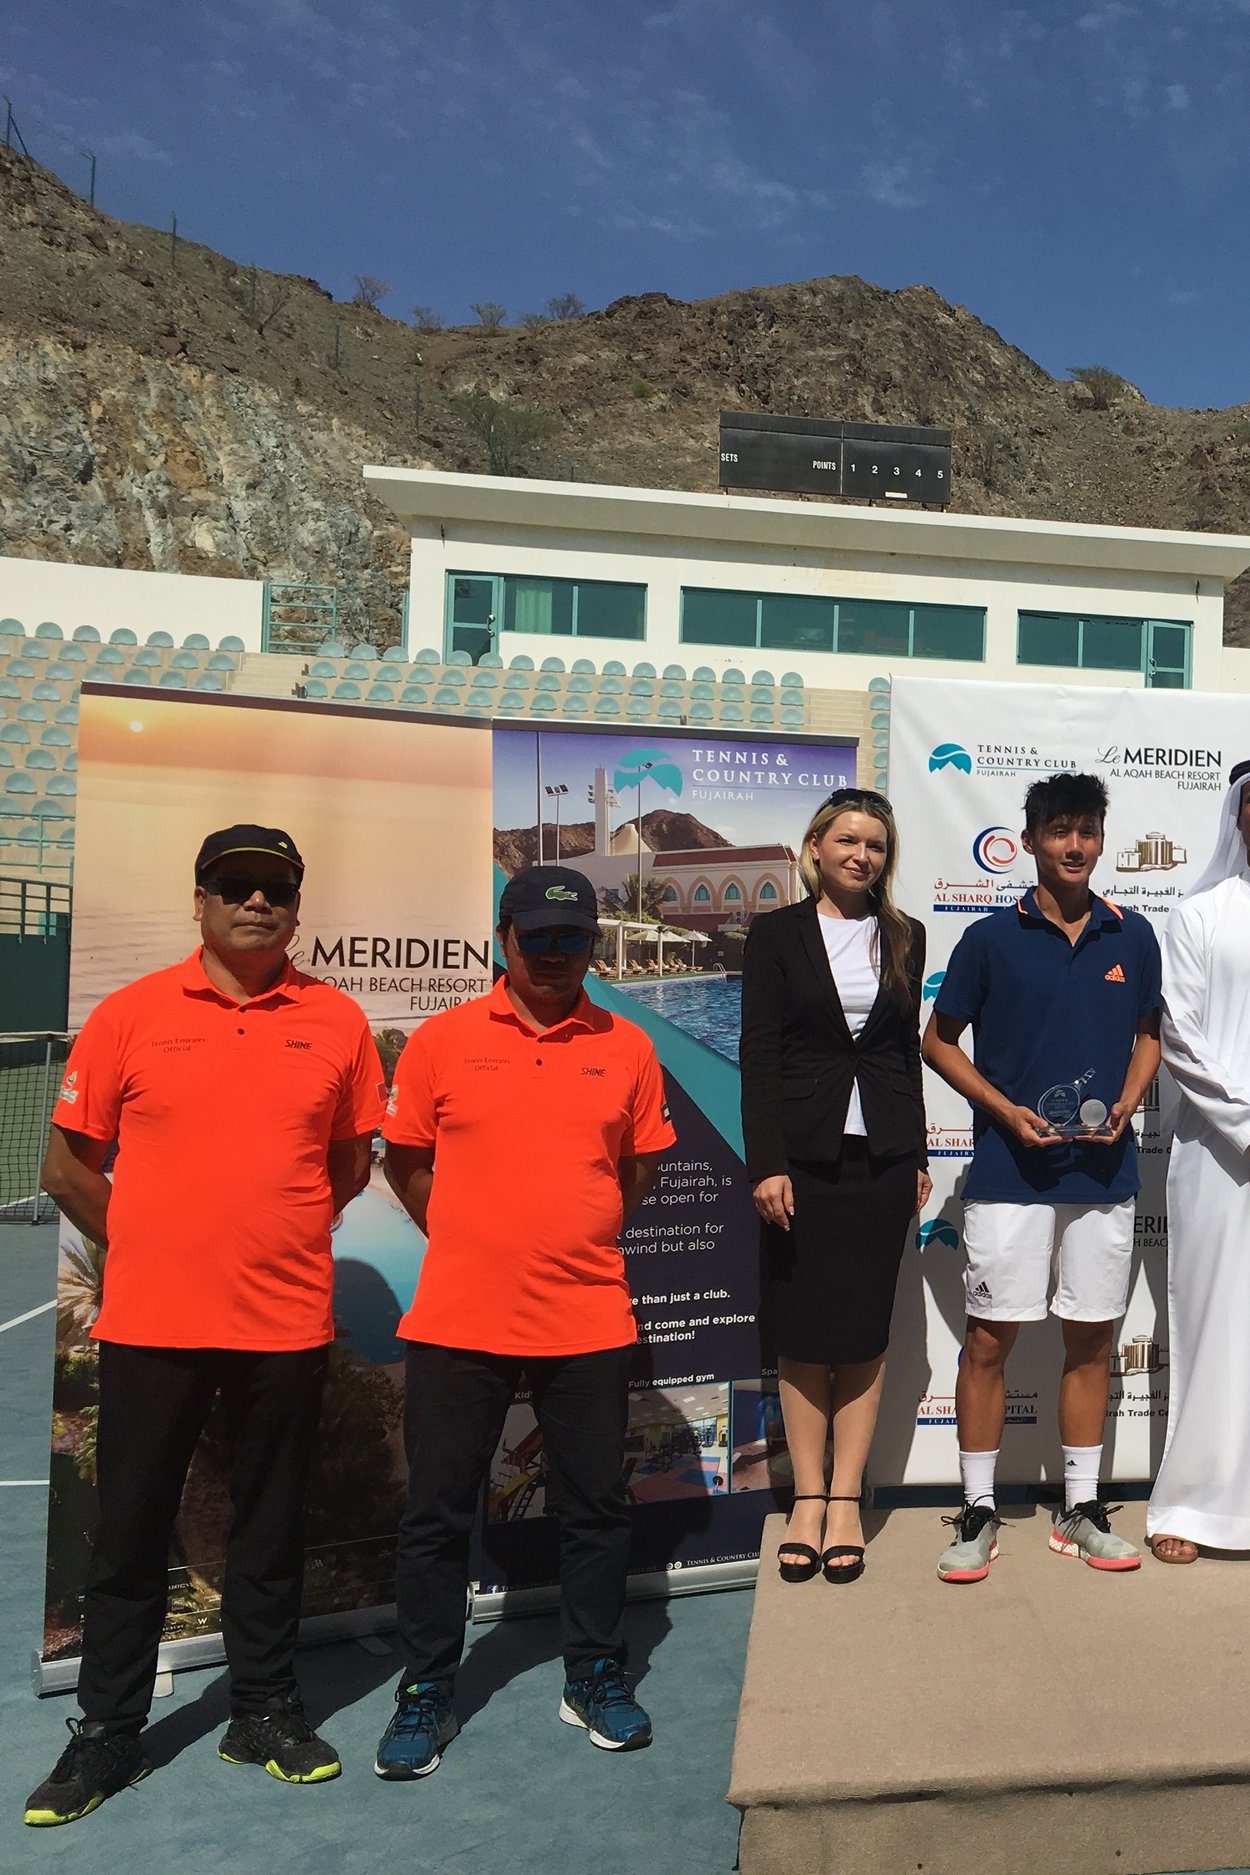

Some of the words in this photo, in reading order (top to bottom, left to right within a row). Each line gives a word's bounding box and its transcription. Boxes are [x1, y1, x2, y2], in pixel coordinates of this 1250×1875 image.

[720, 453, 738, 463] SETS
[812, 460, 836, 470] POINTS
[851, 464, 856, 472] 1
[871, 466, 878, 474] 2
[893, 467, 900, 476] 3
[915, 469, 922, 477] 4
[937, 470, 944, 479] 5
[977, 744, 1026, 755] TENNIS
[1030, 747, 1038, 755] &
[692, 750, 769, 765] TENNIS
[776, 754, 788, 766] &
[977, 756, 1041, 768] COUNTRY
[1044, 759, 1077, 769] CLUB
[1095, 745, 1121, 764] Le
[1124, 748, 1222, 768] MERIDIEN
[692, 769, 792, 785] COUNTRY
[798, 774, 847, 787] CLUB
[1110, 768, 1122, 778] AL
[1123, 768, 1152, 779] AQAH
[1155, 770, 1185, 780] BEACH
[1187, 771, 1221, 781] RESORT
[1177, 781, 1222, 792] FUJAIRAH
[692, 790, 754, 801] FUJAIRAH
[934, 894, 950, 902] AL
[952, 894, 992, 904] SHARQ
[311, 936, 489, 970] MERIDIEN
[369, 978, 422, 992] BEACH
[428, 978, 487, 994] RESORT
[284, 1040, 312, 1050] SHINE
[580, 1068, 606, 1077] SHINE
[928, 1138, 942, 1147] AL
[660, 1176, 718, 1190] Fujairah,
[722, 1174, 732, 1186] is
[660, 1193, 695, 1206] open
[700, 1190, 718, 1202] for
[626, 1223, 700, 1240] destination
[705, 1222, 724, 1234] for
[662, 1240, 684, 1252] but
[688, 1238, 715, 1251] also
[642, 1294, 667, 1305] than
[670, 1292, 691, 1304] just
[694, 1292, 700, 1300] a
[703, 1289, 730, 1300] club.
[972, 1290, 992, 1299] adidas
[655, 1320, 686, 1331] come
[688, 1316, 710, 1327] and
[712, 1314, 756, 1328] explore
[628, 1379, 650, 1389] Fully
[652, 1374, 694, 1386] equipped
[696, 1374, 715, 1384] gym
[918, 1406, 934, 1415] AL
